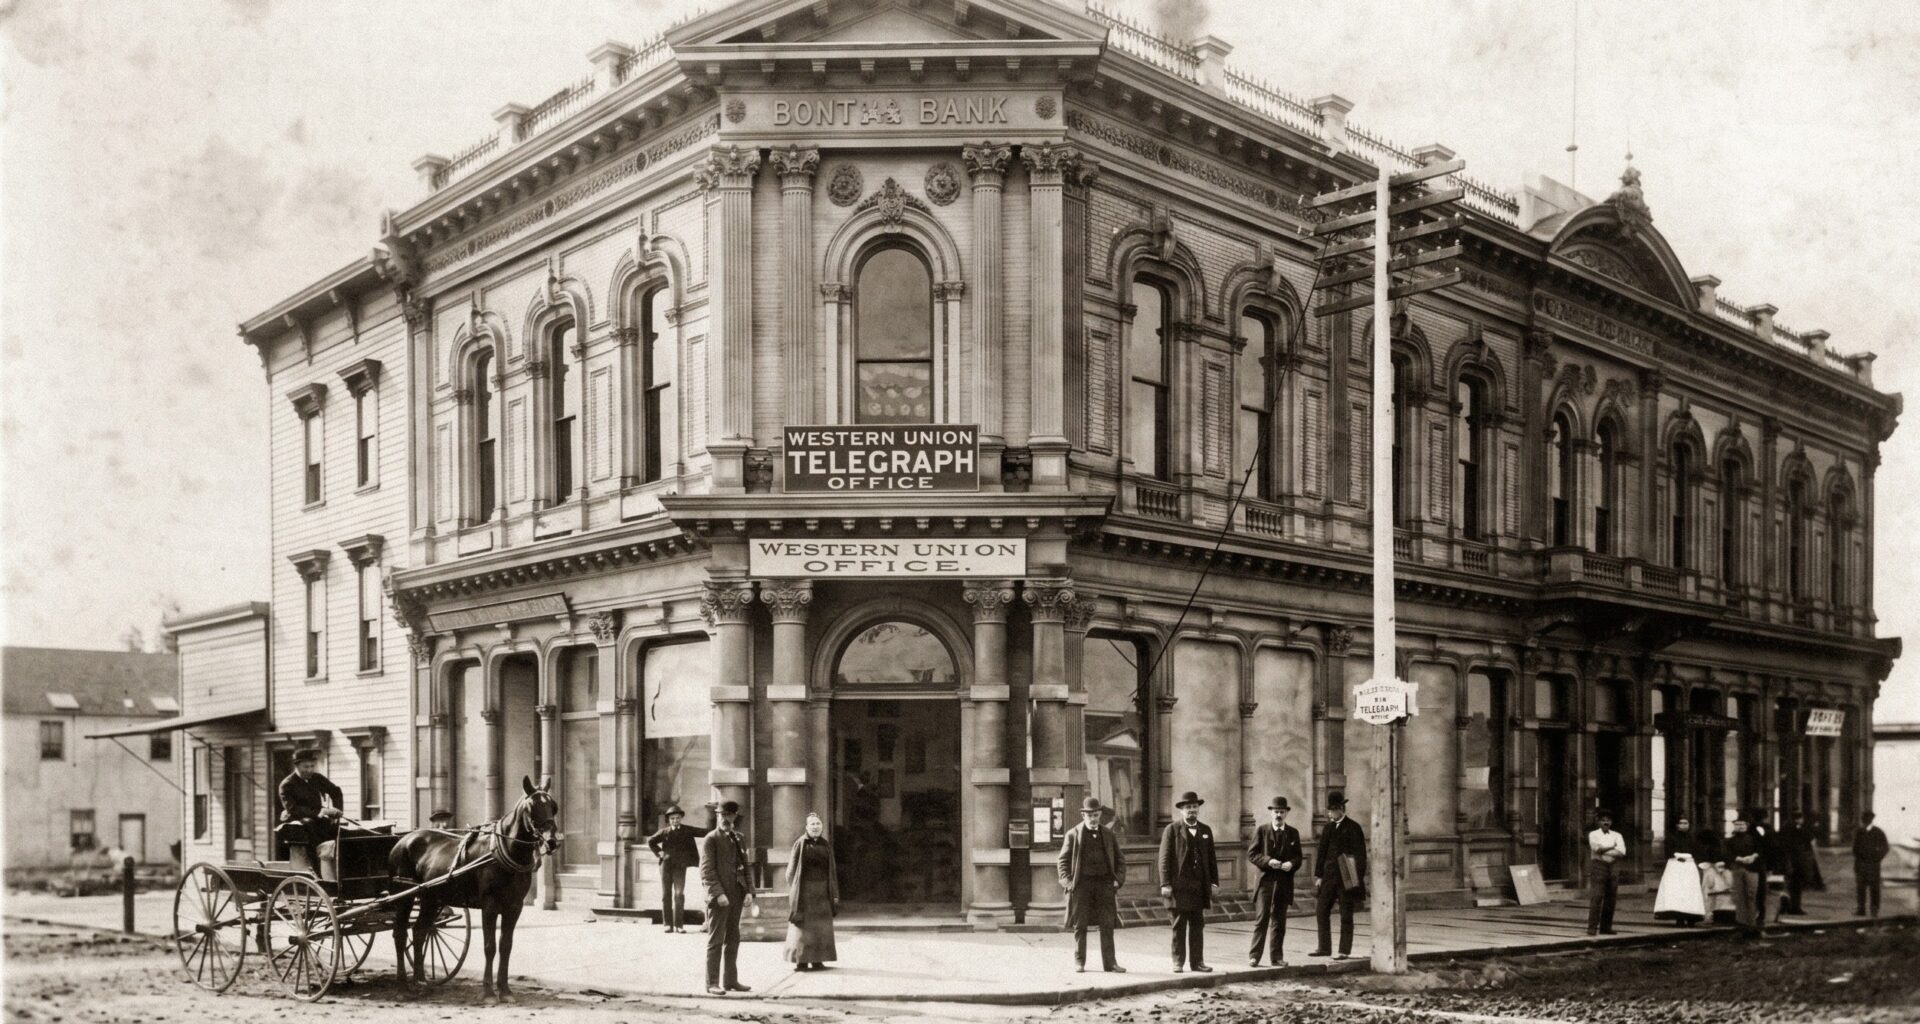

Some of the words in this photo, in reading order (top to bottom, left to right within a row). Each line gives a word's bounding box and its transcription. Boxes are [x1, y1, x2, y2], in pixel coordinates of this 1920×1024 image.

[919, 96, 1008, 124] BANK
[788, 431, 895, 446] WESTERN
[904, 430, 973, 445] UNION
[788, 450, 974, 475] TELEGRAPH
[827, 476, 933, 490] OFFICE
[758, 542, 900, 556] WESTERN
[915, 543, 1017, 556] UNION
[803, 560, 971, 573] OFFICE.
[1360, 704, 1399, 714] TELEGRAPH
